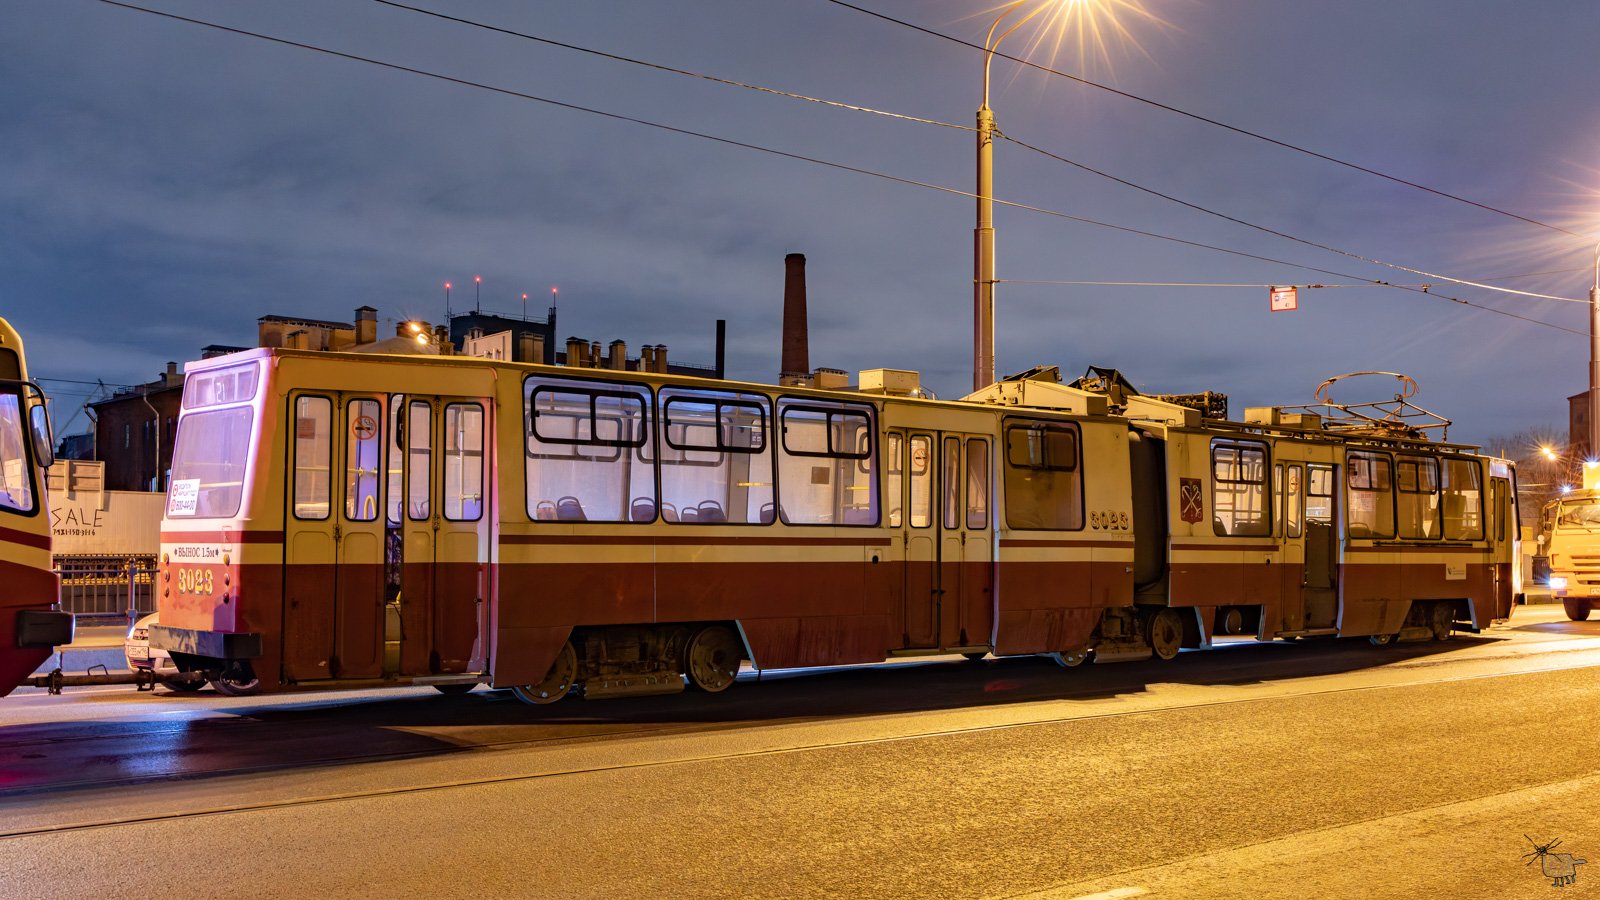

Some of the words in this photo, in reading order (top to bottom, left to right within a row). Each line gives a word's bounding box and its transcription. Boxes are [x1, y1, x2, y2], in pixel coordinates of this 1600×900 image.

[51, 507, 105, 528] SALE
[1090, 511, 1129, 530] 3023
[178, 547, 200, 558] ВЫНОС
[178, 567, 214, 596] 3023
